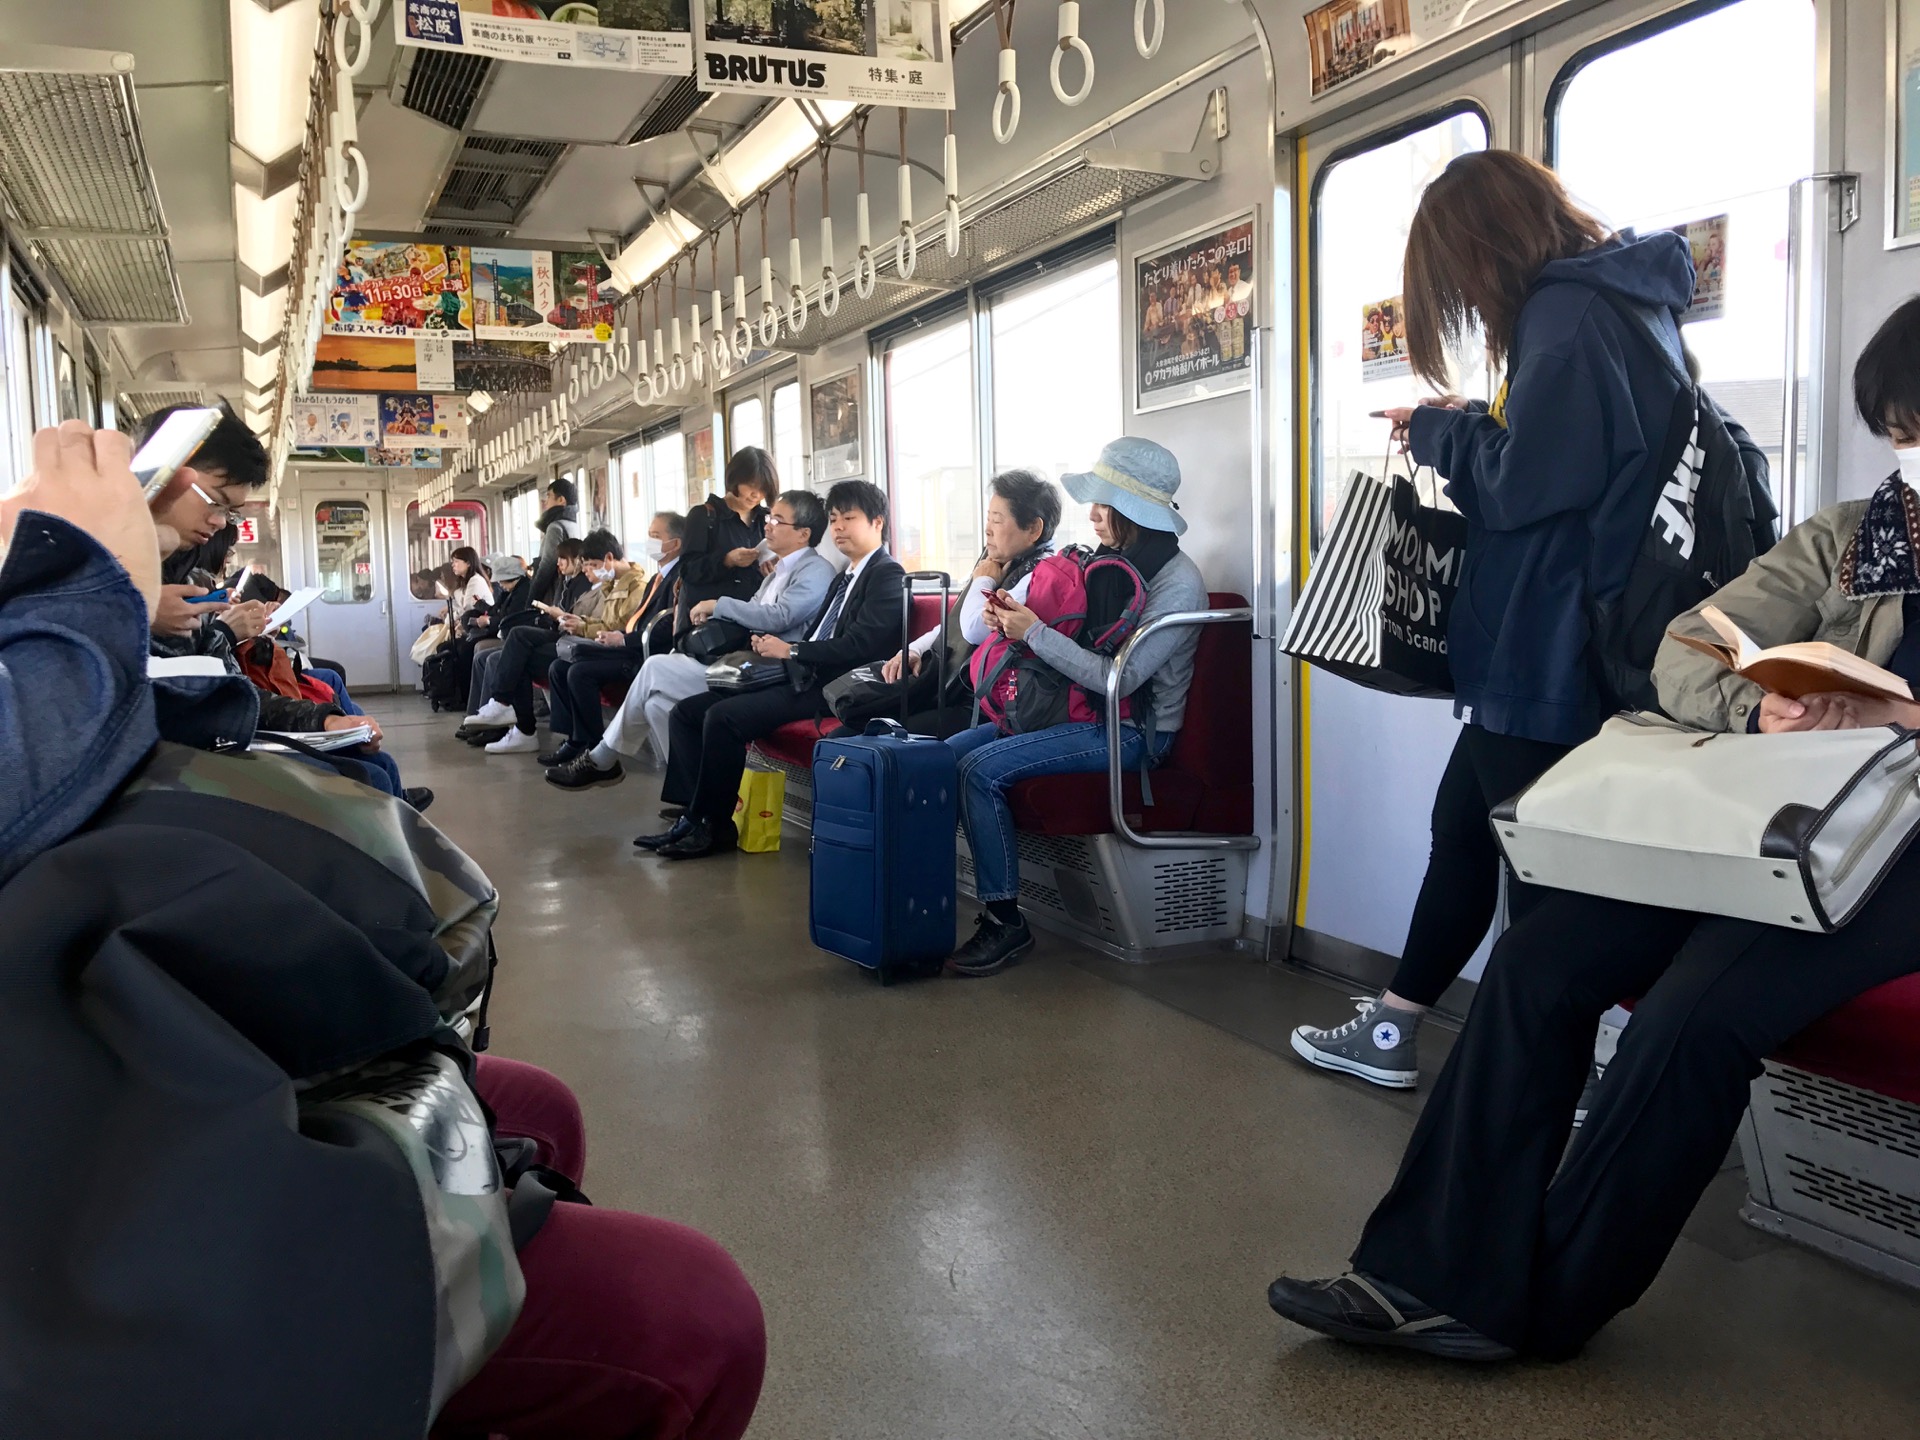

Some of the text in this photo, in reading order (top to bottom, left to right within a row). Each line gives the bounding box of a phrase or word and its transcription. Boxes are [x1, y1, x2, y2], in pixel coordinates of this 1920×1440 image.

[416, 15, 455, 36] 松阪
[704, 52, 827, 88] BRUTUS
[868, 67, 923, 85] 特集・庭
[535, 266, 550, 310] 秋ハイク
[331, 322, 407, 336] 志摩スペイン村
[1385, 564, 1442, 627] SHOP
